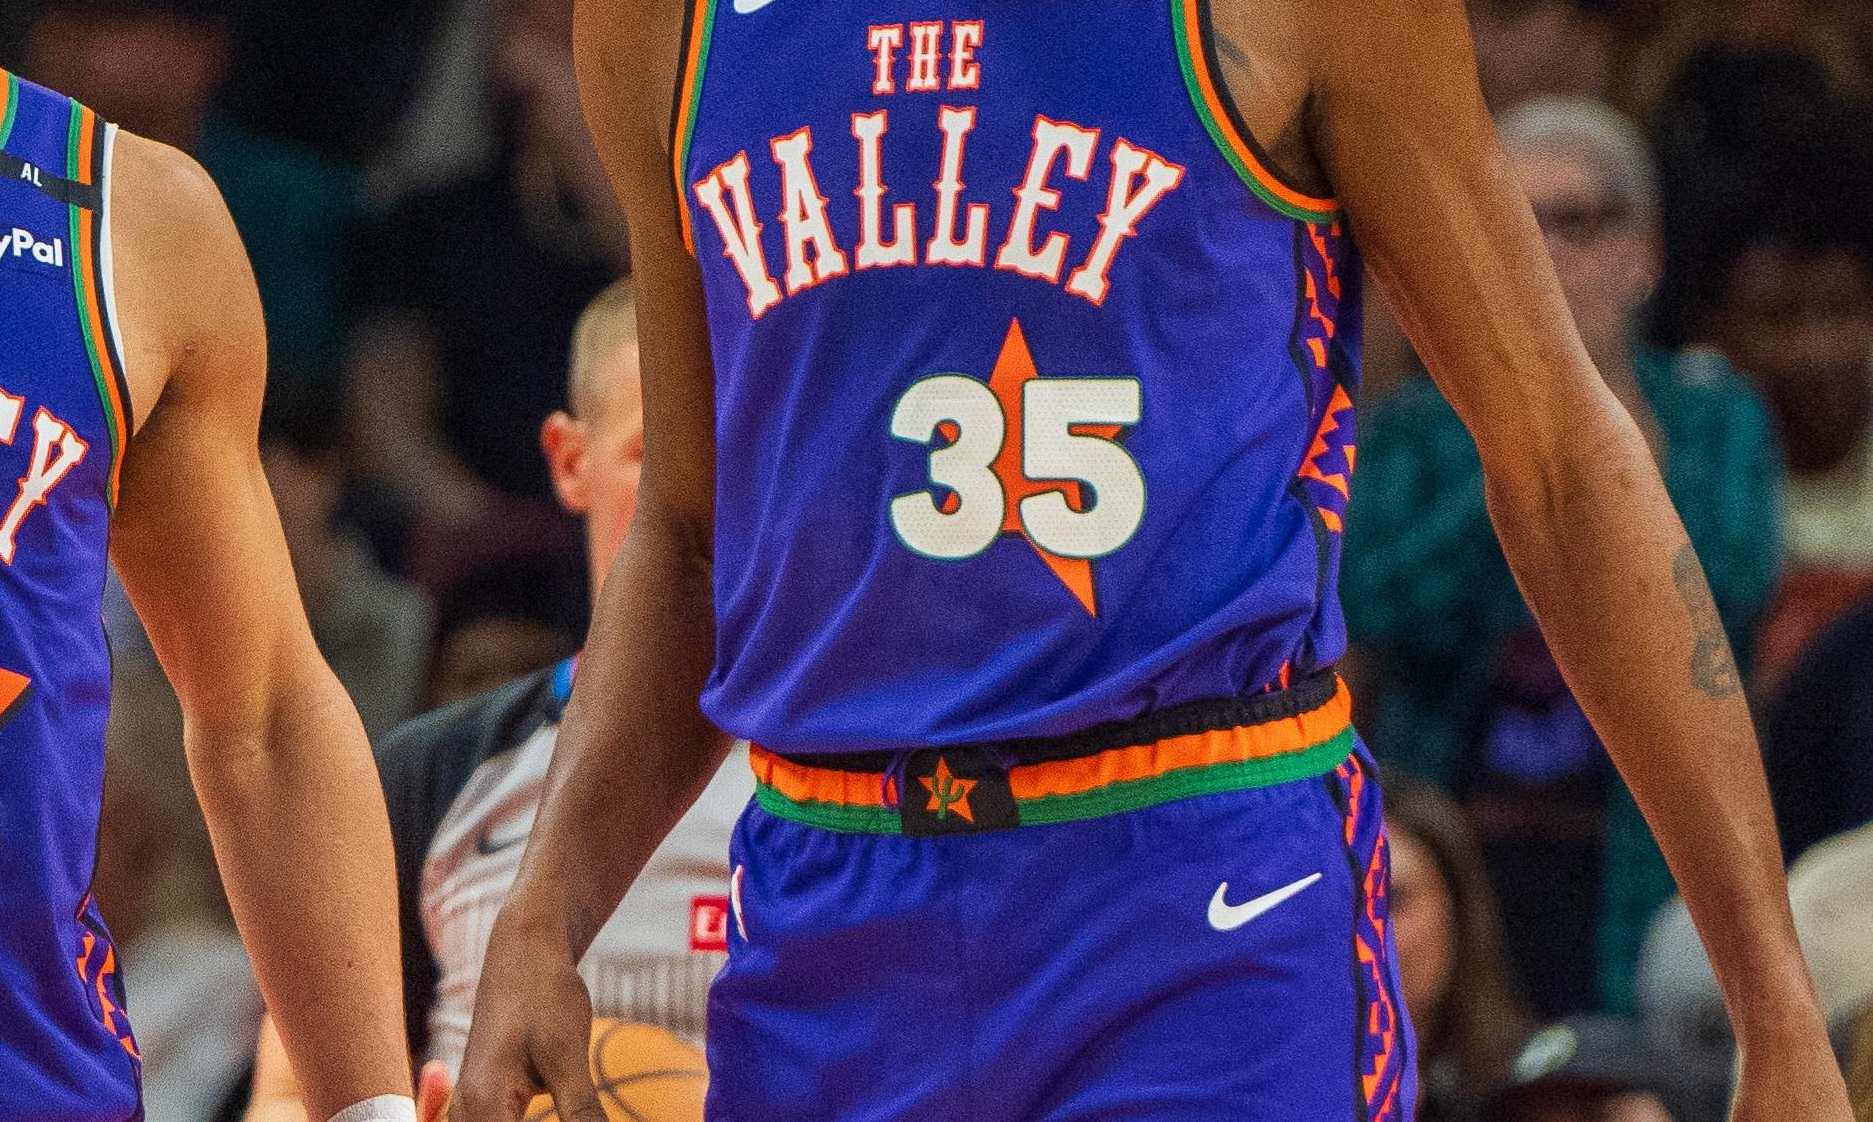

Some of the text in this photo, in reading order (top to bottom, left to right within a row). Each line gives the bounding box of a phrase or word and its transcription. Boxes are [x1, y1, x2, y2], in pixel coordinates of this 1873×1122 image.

[869, 20, 983, 95] THE
[20, 162, 43, 188] AL
[693, 105, 1186, 320] VALLEY
[889, 374, 1147, 559] 35
